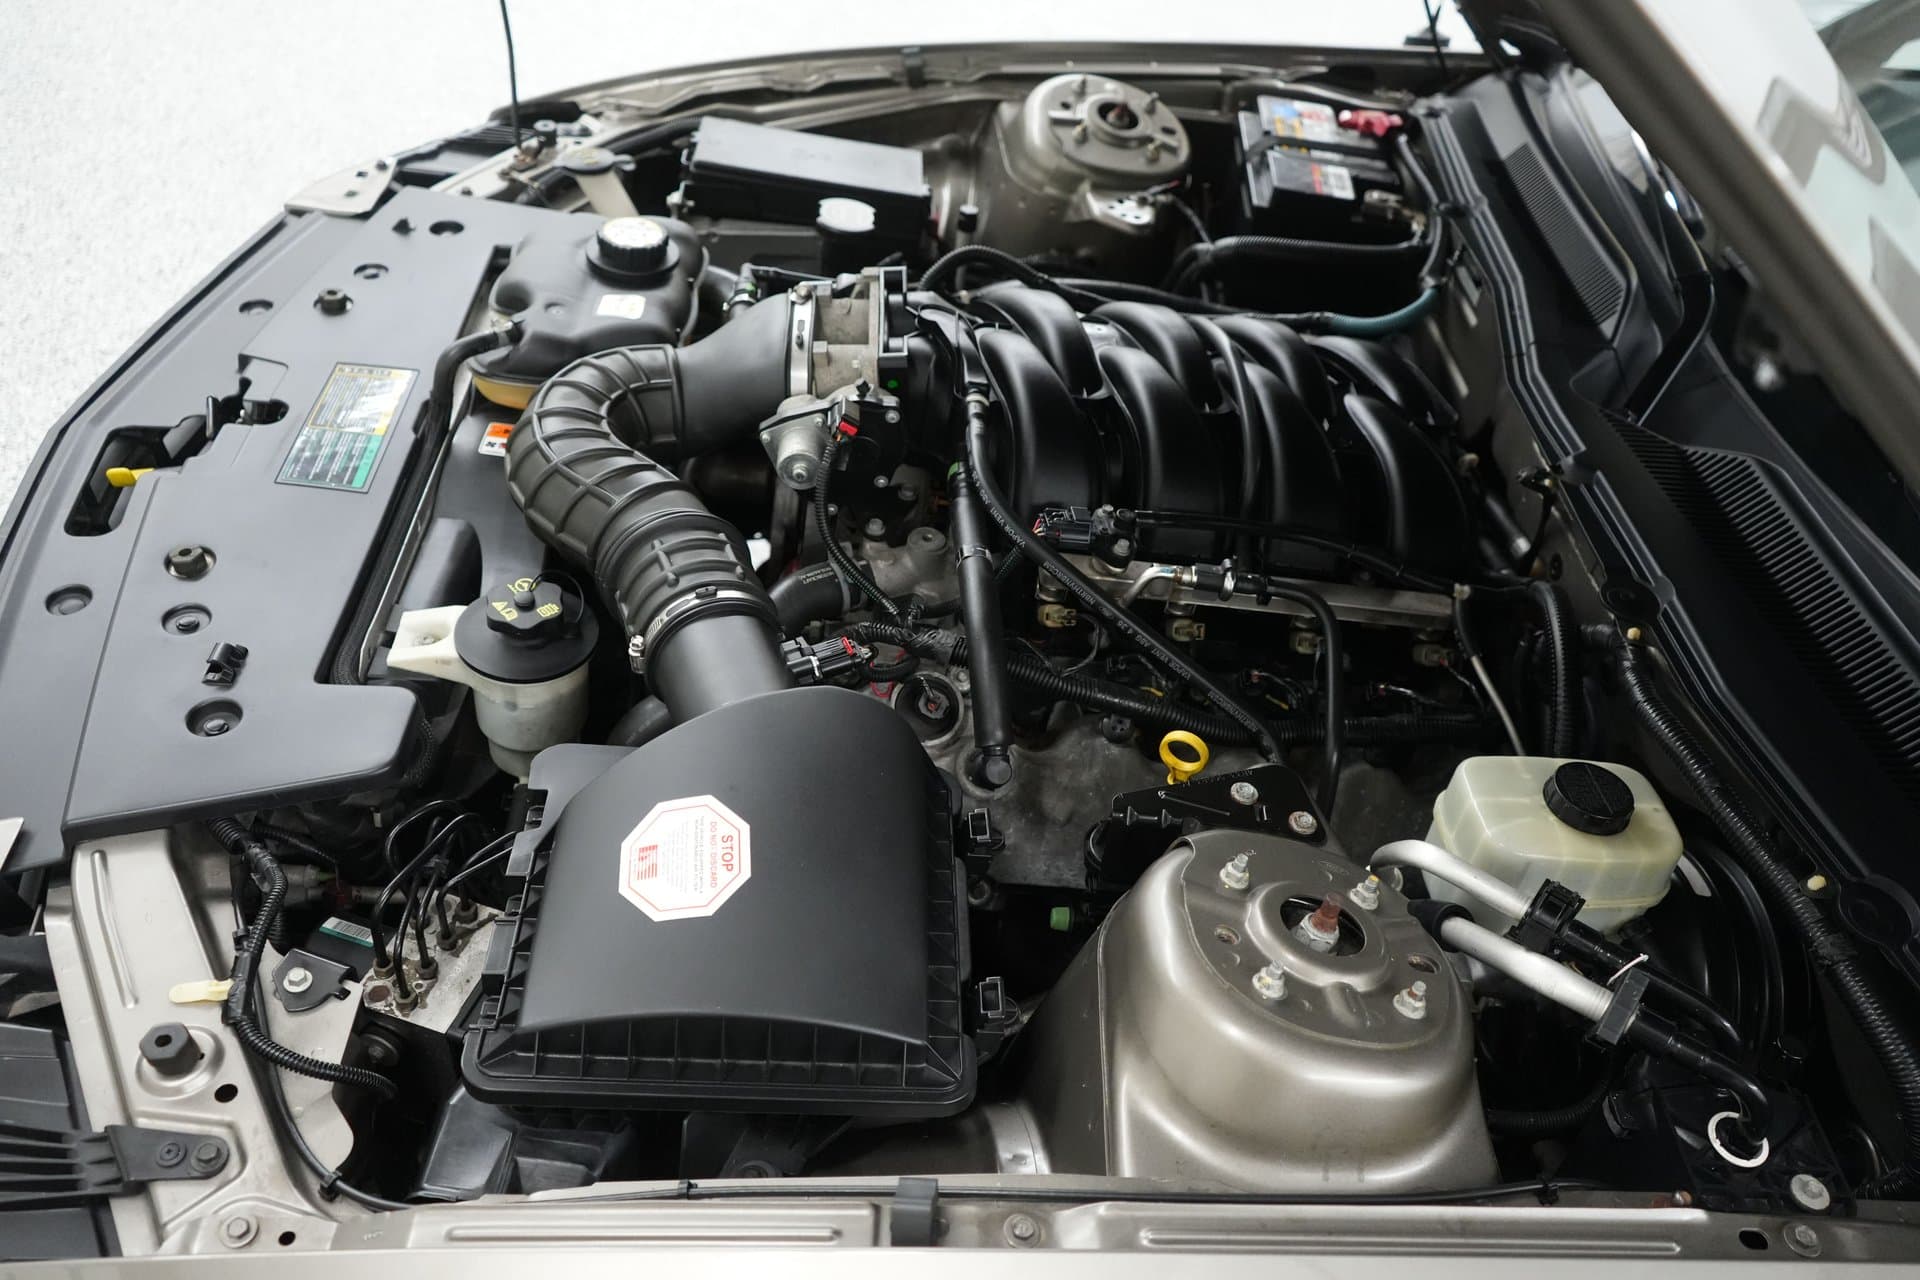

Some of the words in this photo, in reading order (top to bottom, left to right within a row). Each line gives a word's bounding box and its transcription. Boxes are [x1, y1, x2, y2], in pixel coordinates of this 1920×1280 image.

[710, 821, 718, 833] DO
[710, 852, 718, 888] DISCARD
[721, 834, 734, 872] STOP
